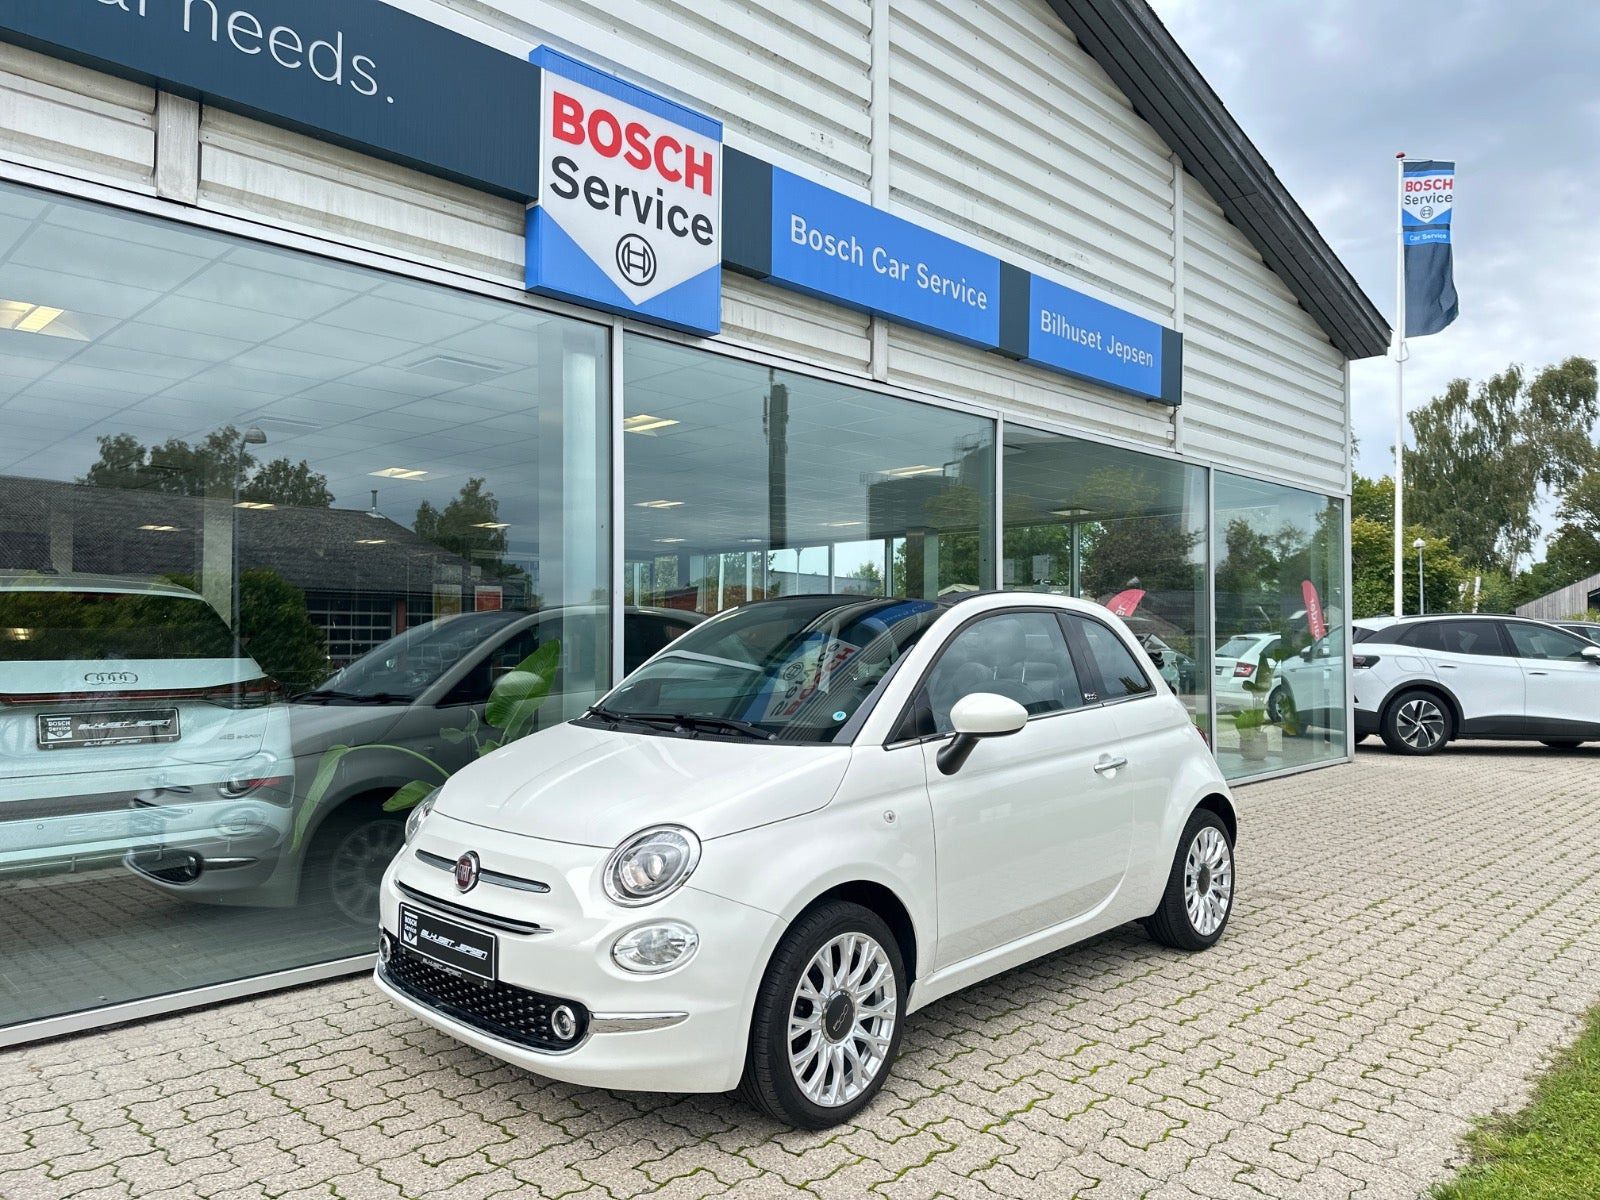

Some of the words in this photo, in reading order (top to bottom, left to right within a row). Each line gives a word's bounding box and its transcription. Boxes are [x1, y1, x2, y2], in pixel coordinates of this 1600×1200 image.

[183, 0, 394, 104] needs.
[553, 91, 712, 196] BOSCH
[1405, 178, 1453, 192] BOSCH
[550, 156, 713, 246] Service
[1403, 192, 1453, 205] Service
[791, 214, 864, 267] Bosch
[872, 247, 909, 281] Car
[916, 263, 987, 310] Service
[1041, 309, 1102, 350] Bilhuset
[1106, 335, 1153, 367] Jepsen
